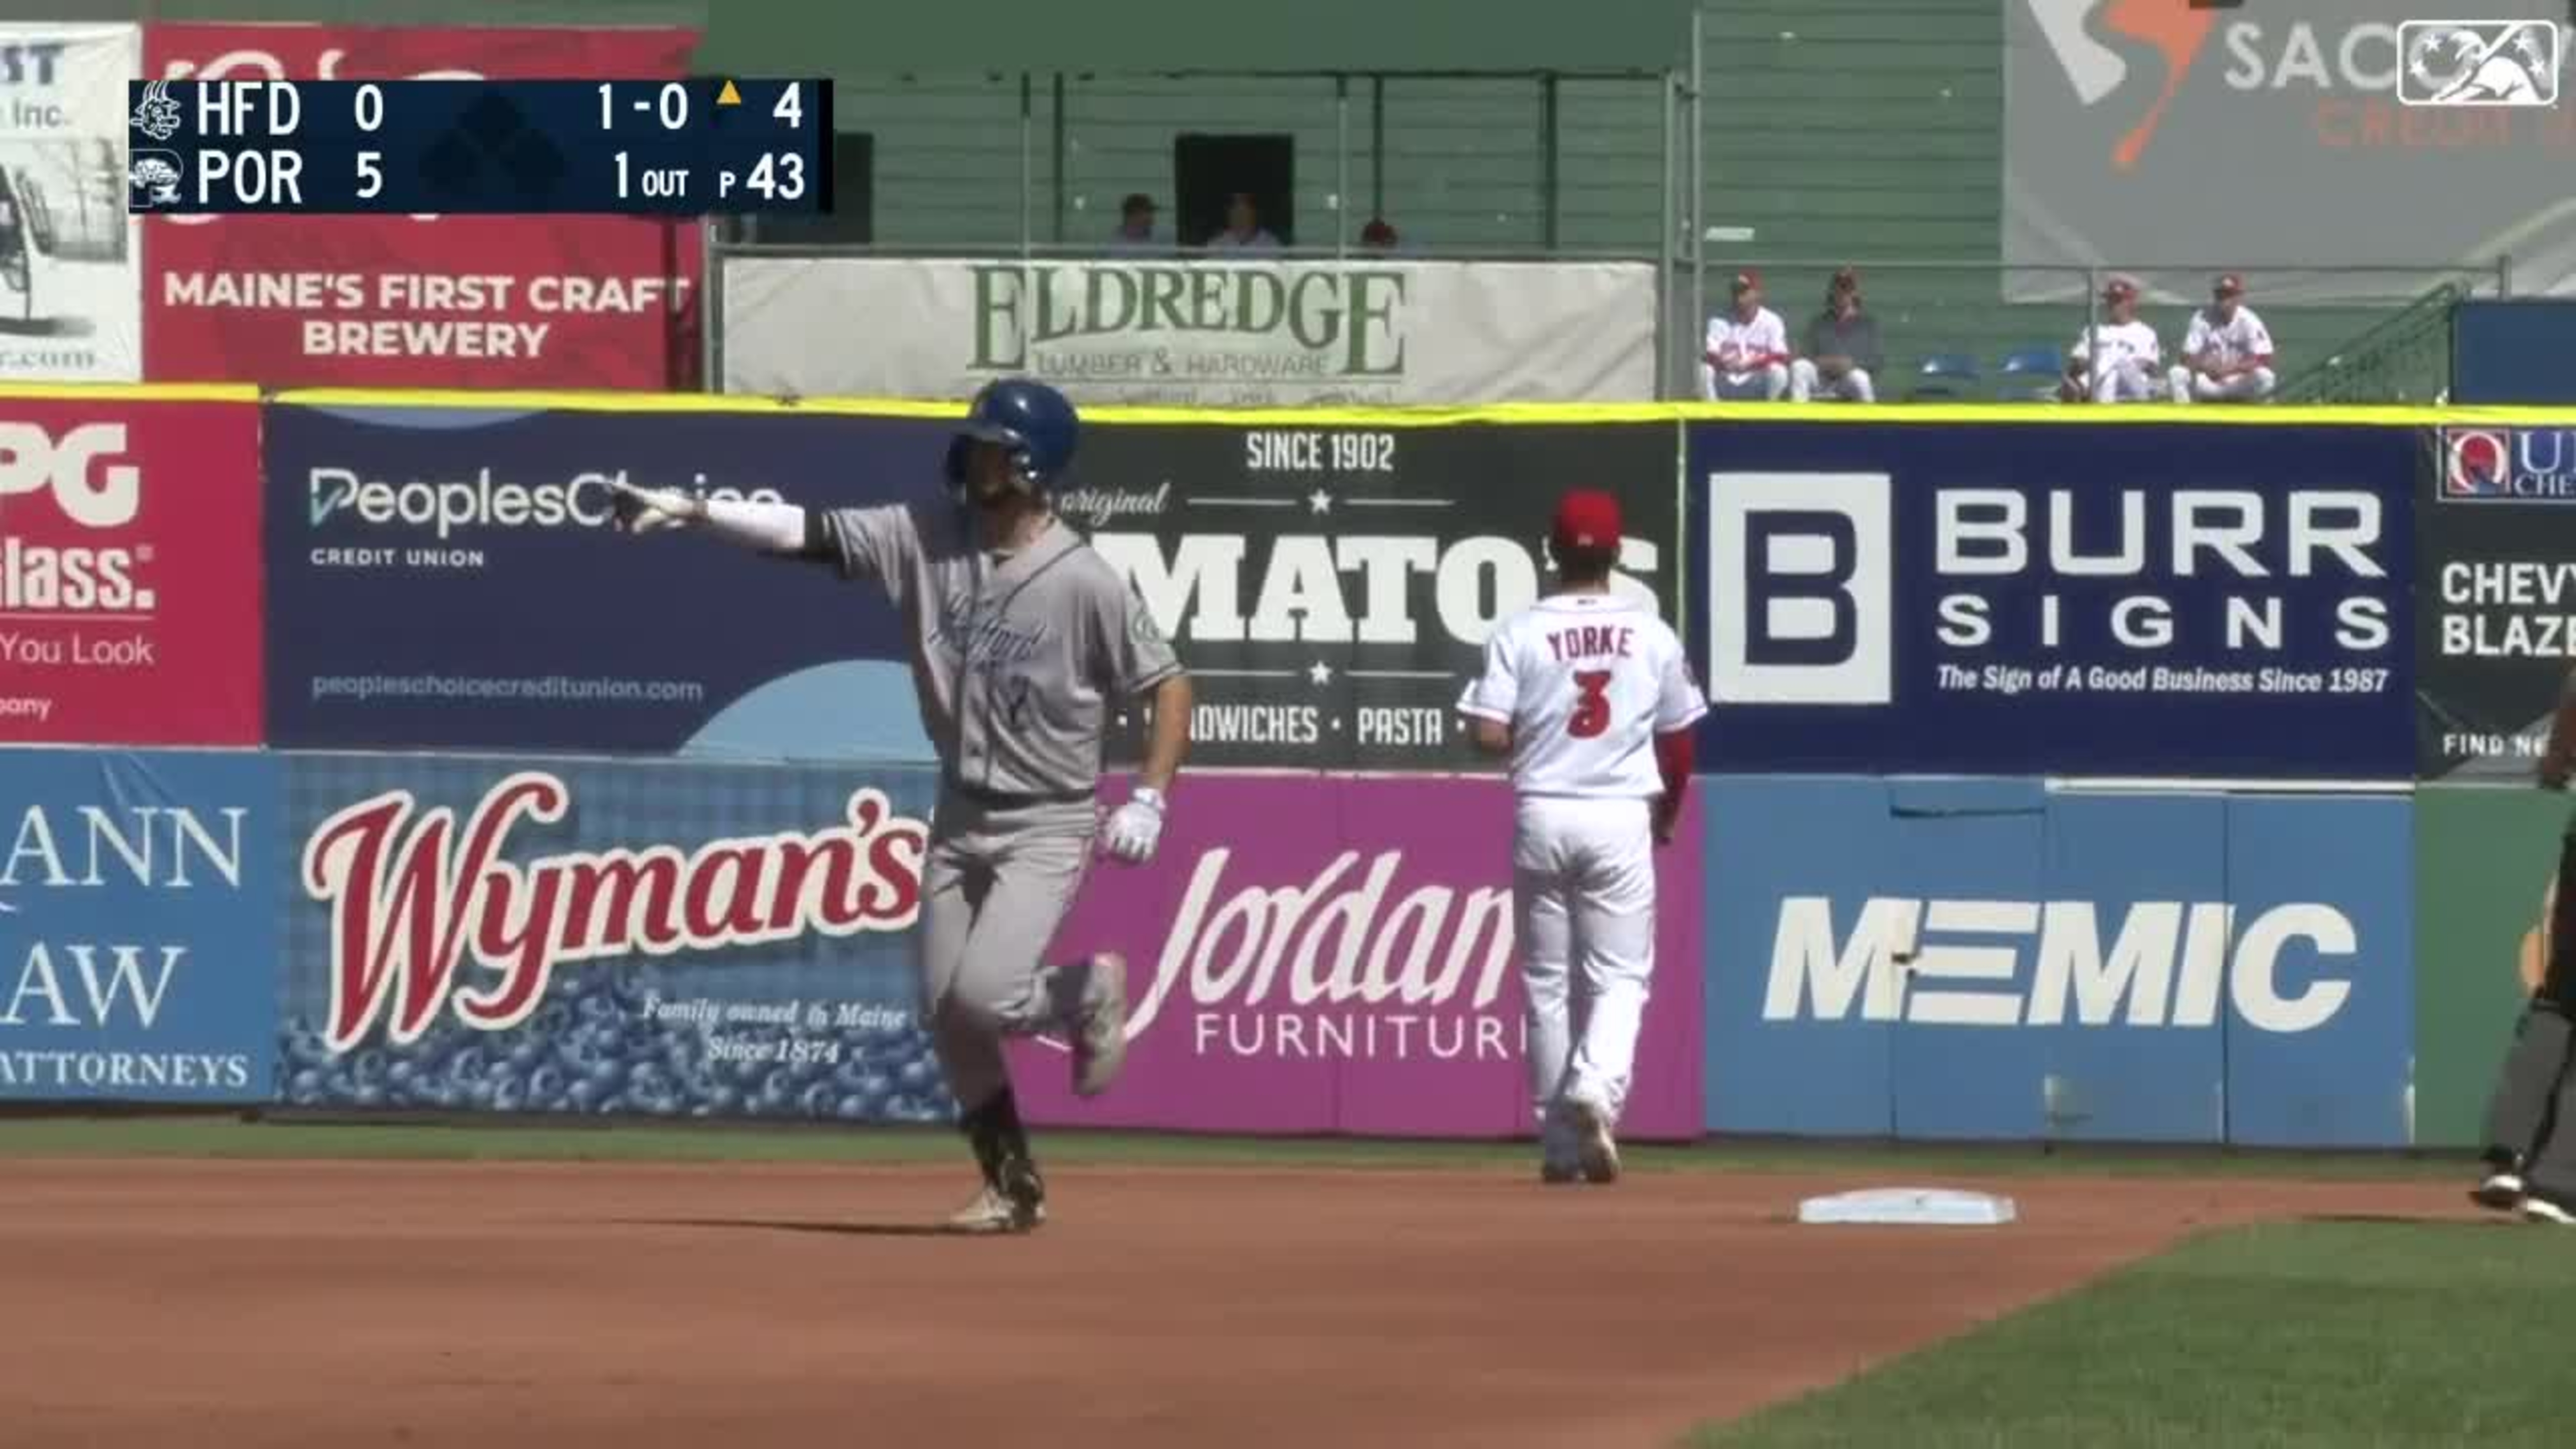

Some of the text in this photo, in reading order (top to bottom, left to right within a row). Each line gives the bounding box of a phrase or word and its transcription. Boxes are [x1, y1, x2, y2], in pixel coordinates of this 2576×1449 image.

[164, 272, 690, 312] MAINE'S FIRST CRAFT
[303, 320, 549, 357] BREWERY
[966, 265, 1405, 375] ELDREDGE
[1034, 347, 1328, 375] LUMBER & HARDWARE
[1247, 433, 1394, 471] SINCE 1902
[2517, 431, 2576, 474] U
[1061, 481, 1171, 526] original
[1936, 490, 2389, 576] BURR
[0, 537, 154, 609] lass.
[311, 549, 484, 567] CREDIT UNION
[1743, 509, 1857, 666] B
[1937, 594, 2390, 650] SIGNS
[0, 631, 154, 664] You Look
[1547, 625, 1634, 661] YORKE
[312, 674, 702, 702] peopleschoicecreditunion.com
[1938, 665, 2389, 695] The Sign of A Good Business Since 1987
[1567, 670, 1612, 739] 3
[1358, 708, 1442, 744] PASTA
[2443, 734, 2503, 756] FIND
[307, 776, 926, 1047] Wyman's
[1762, 896, 2357, 1034] MEMIC
[644, 997, 907, 1030] Family owned in Maine
[708, 1036, 840, 1063] Since 1874
[1196, 1014, 1527, 1060] FURNITUR
